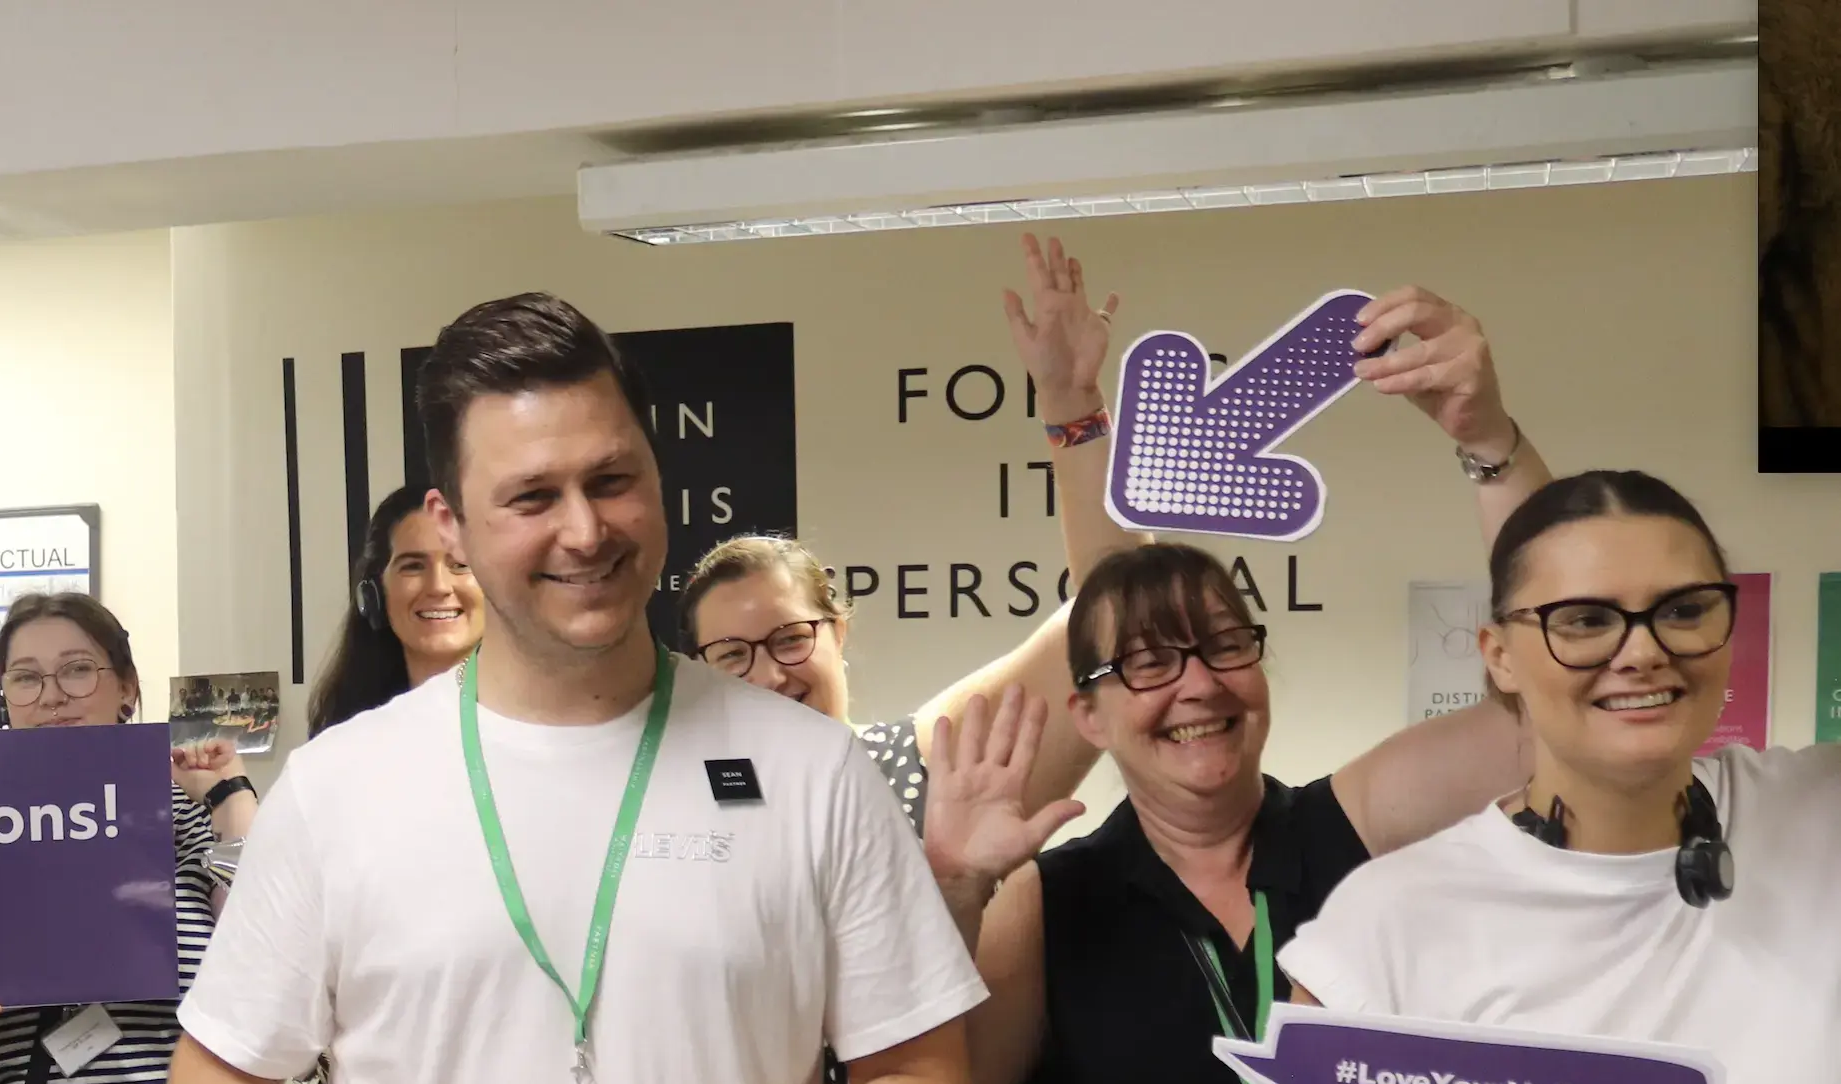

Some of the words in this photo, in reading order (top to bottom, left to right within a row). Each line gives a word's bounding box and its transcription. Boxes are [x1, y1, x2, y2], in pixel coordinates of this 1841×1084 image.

[999, 461, 1055, 518] IT
[845, 554, 1325, 620] PERSAL
[721, 770, 743, 779] SEAN
